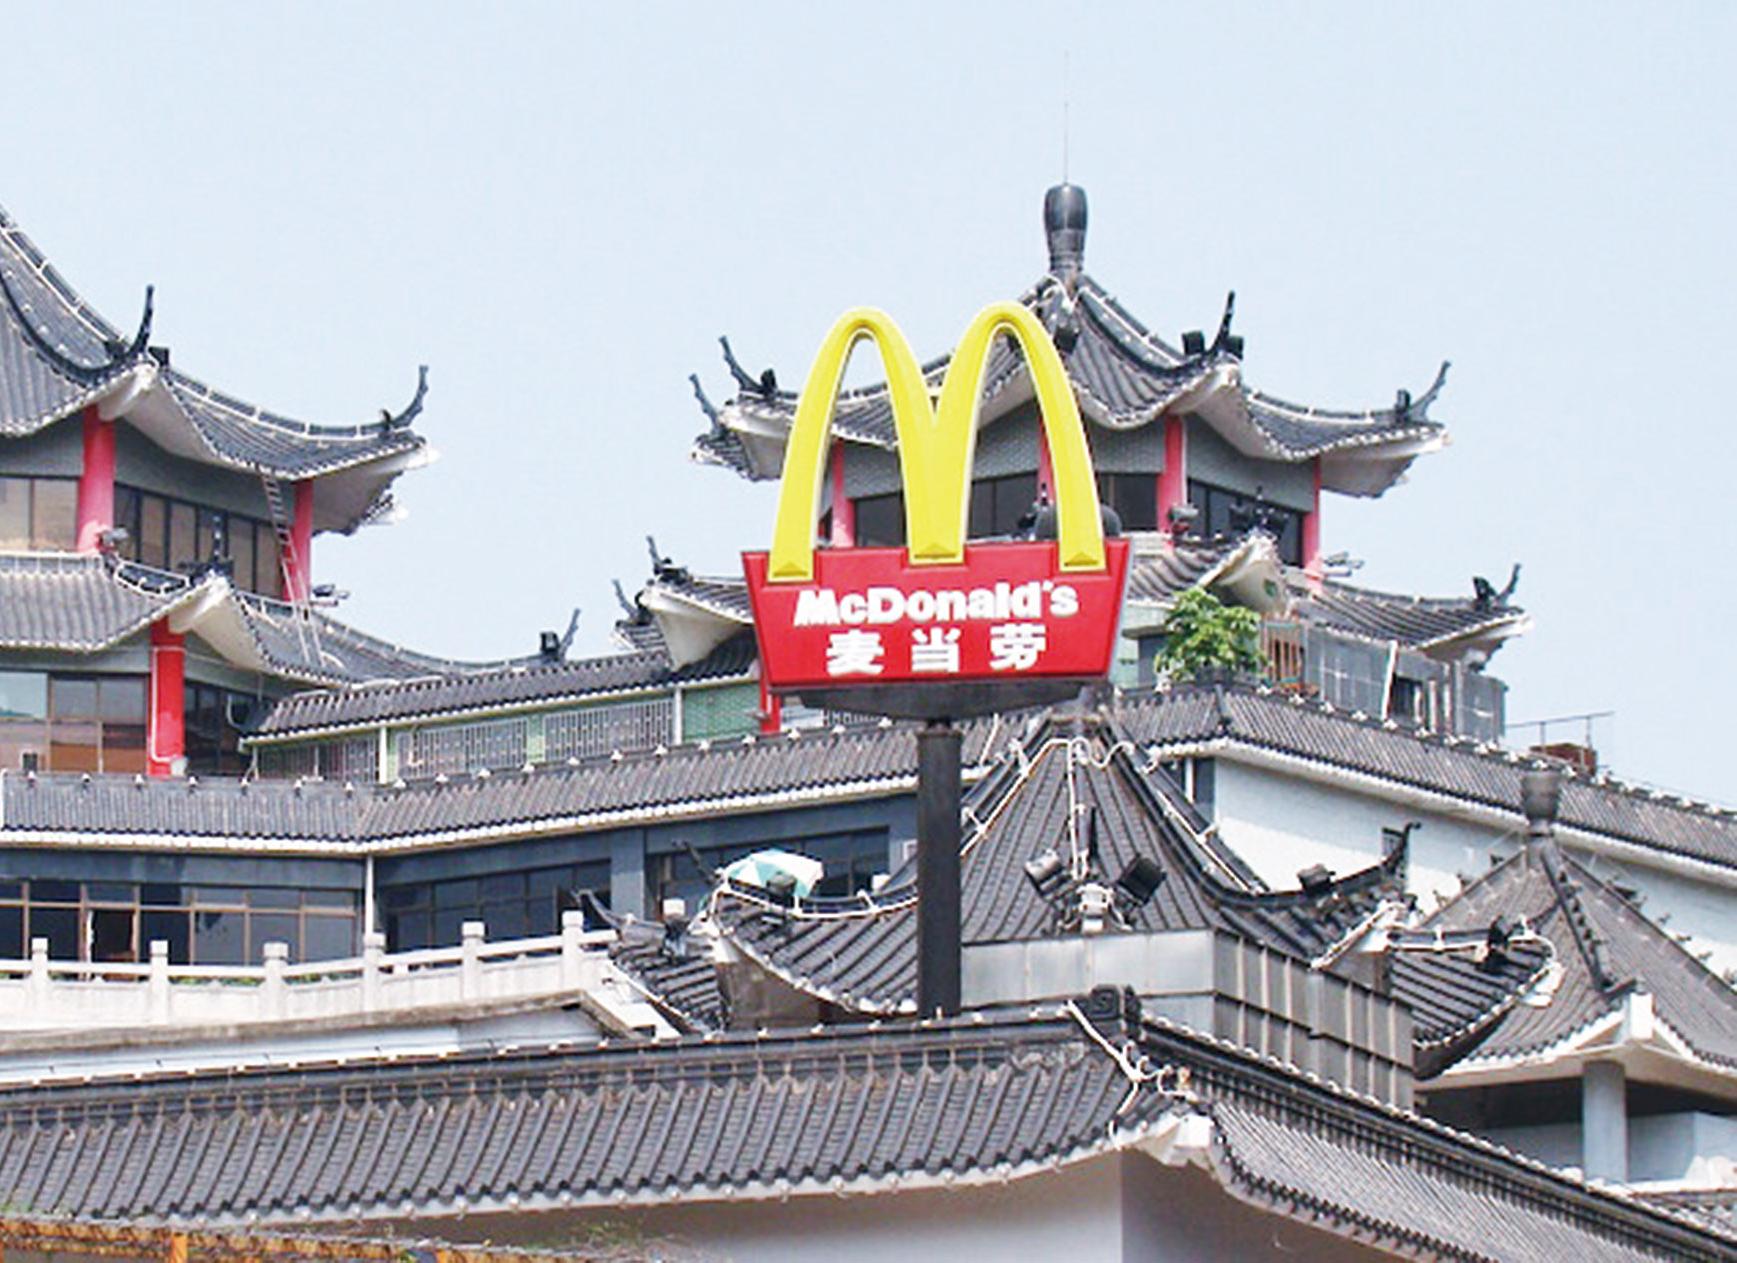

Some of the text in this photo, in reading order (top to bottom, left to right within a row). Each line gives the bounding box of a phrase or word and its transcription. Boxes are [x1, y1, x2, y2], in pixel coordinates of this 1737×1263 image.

[793, 579, 1079, 627] McDonald's
[826, 622, 1046, 677] 麦当劳
